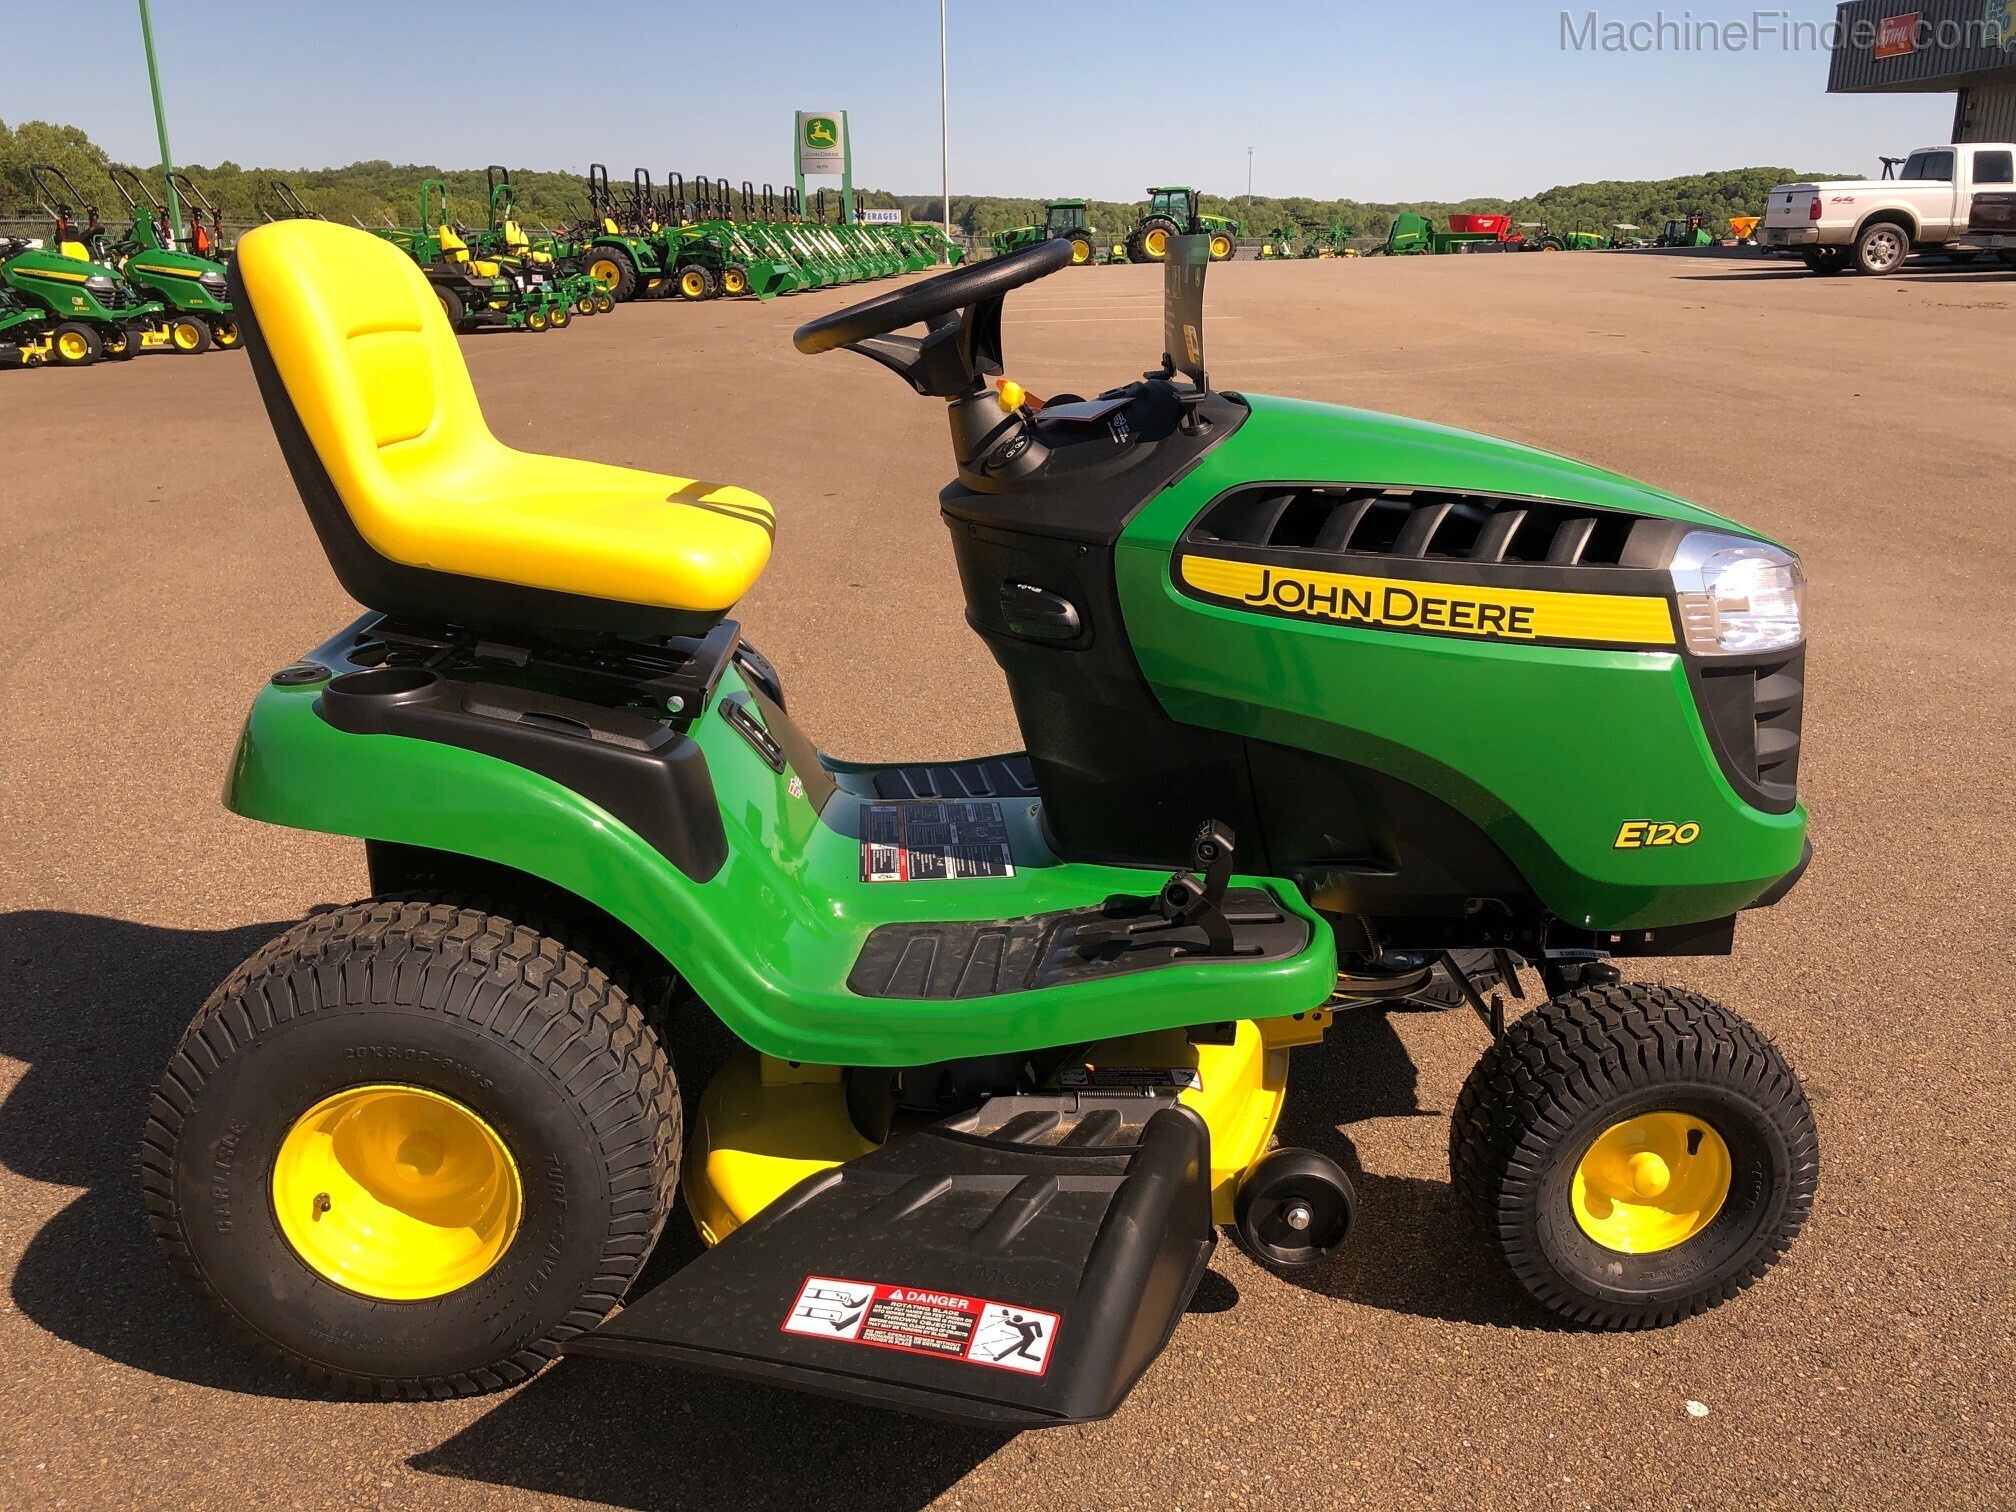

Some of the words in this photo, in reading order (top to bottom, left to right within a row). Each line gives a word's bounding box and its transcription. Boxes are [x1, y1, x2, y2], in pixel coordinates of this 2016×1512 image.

[1245, 568, 1371, 619] JOHN
[1382, 588, 1535, 635] DEERE
[1613, 820, 1701, 850] E120
[890, 1301, 931, 1311] ROTATING
[932, 1307, 960, 1316] BLADE
[906, 1291, 969, 1309] DANGER
[884, 1314, 918, 1323] THROWN
[920, 1320, 957, 1330] OBJECTS
